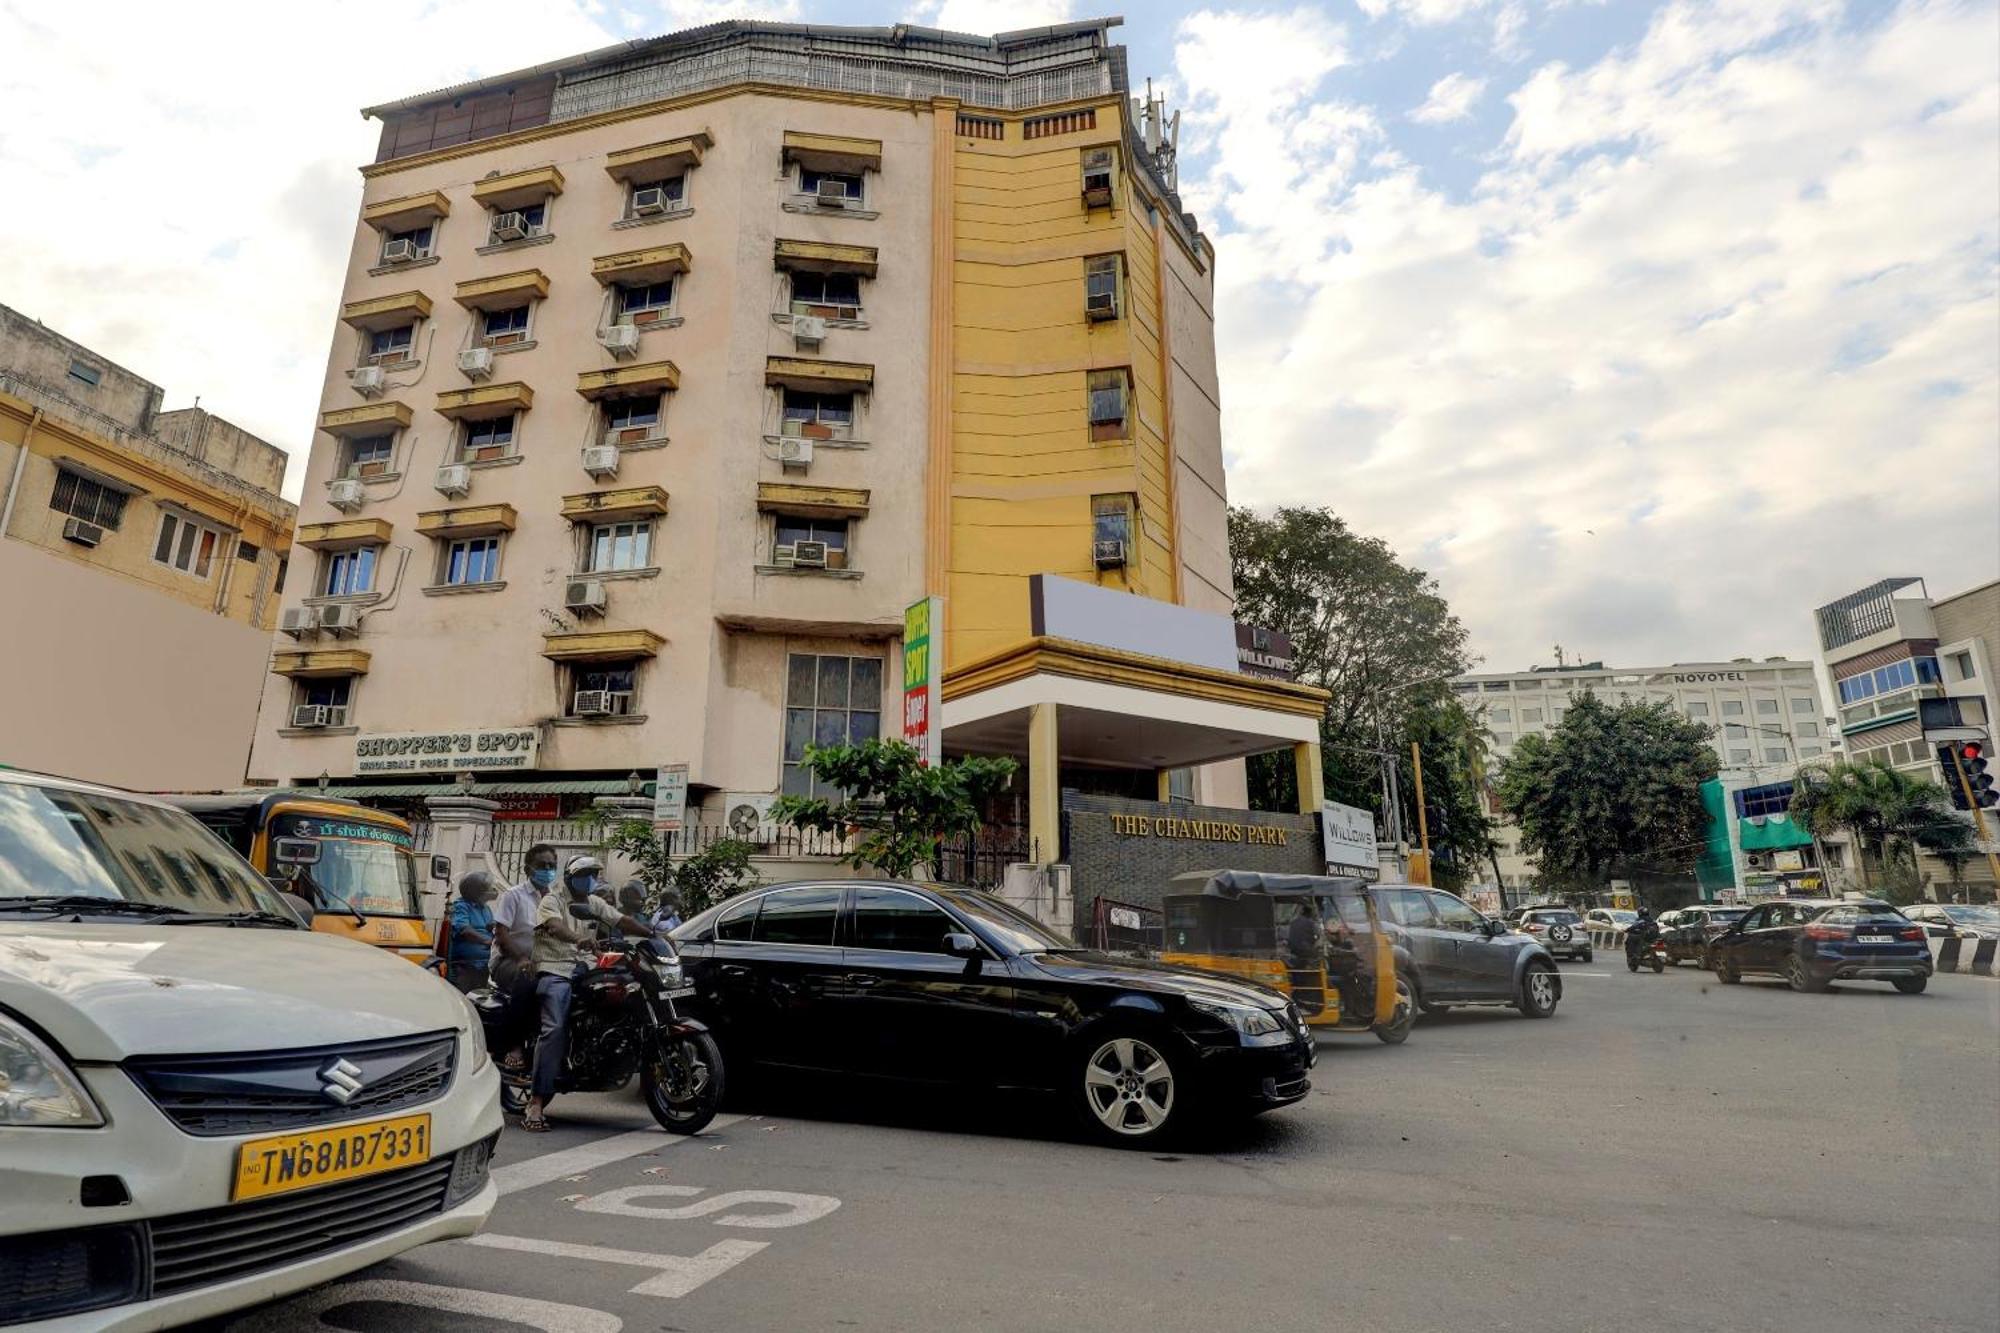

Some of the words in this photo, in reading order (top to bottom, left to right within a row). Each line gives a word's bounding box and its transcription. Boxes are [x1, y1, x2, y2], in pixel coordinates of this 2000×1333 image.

[906, 647, 926, 685] SPOT
[1237, 648, 1292, 670] WILLOWS
[1674, 672, 1745, 683] NOVOTEL
[356, 734, 472, 757] SHOPPER'S
[476, 731, 534, 751] SPOT
[500, 801, 540, 810] SPOT
[1111, 814, 1149, 836] THE
[1155, 816, 1242, 842] CHAMIERS
[1247, 825, 1288, 846] PARK
[1329, 821, 1373, 845] WILLOWS
[243, 1164, 261, 1175] IND
[261, 1124, 426, 1185] TN68AB7331
